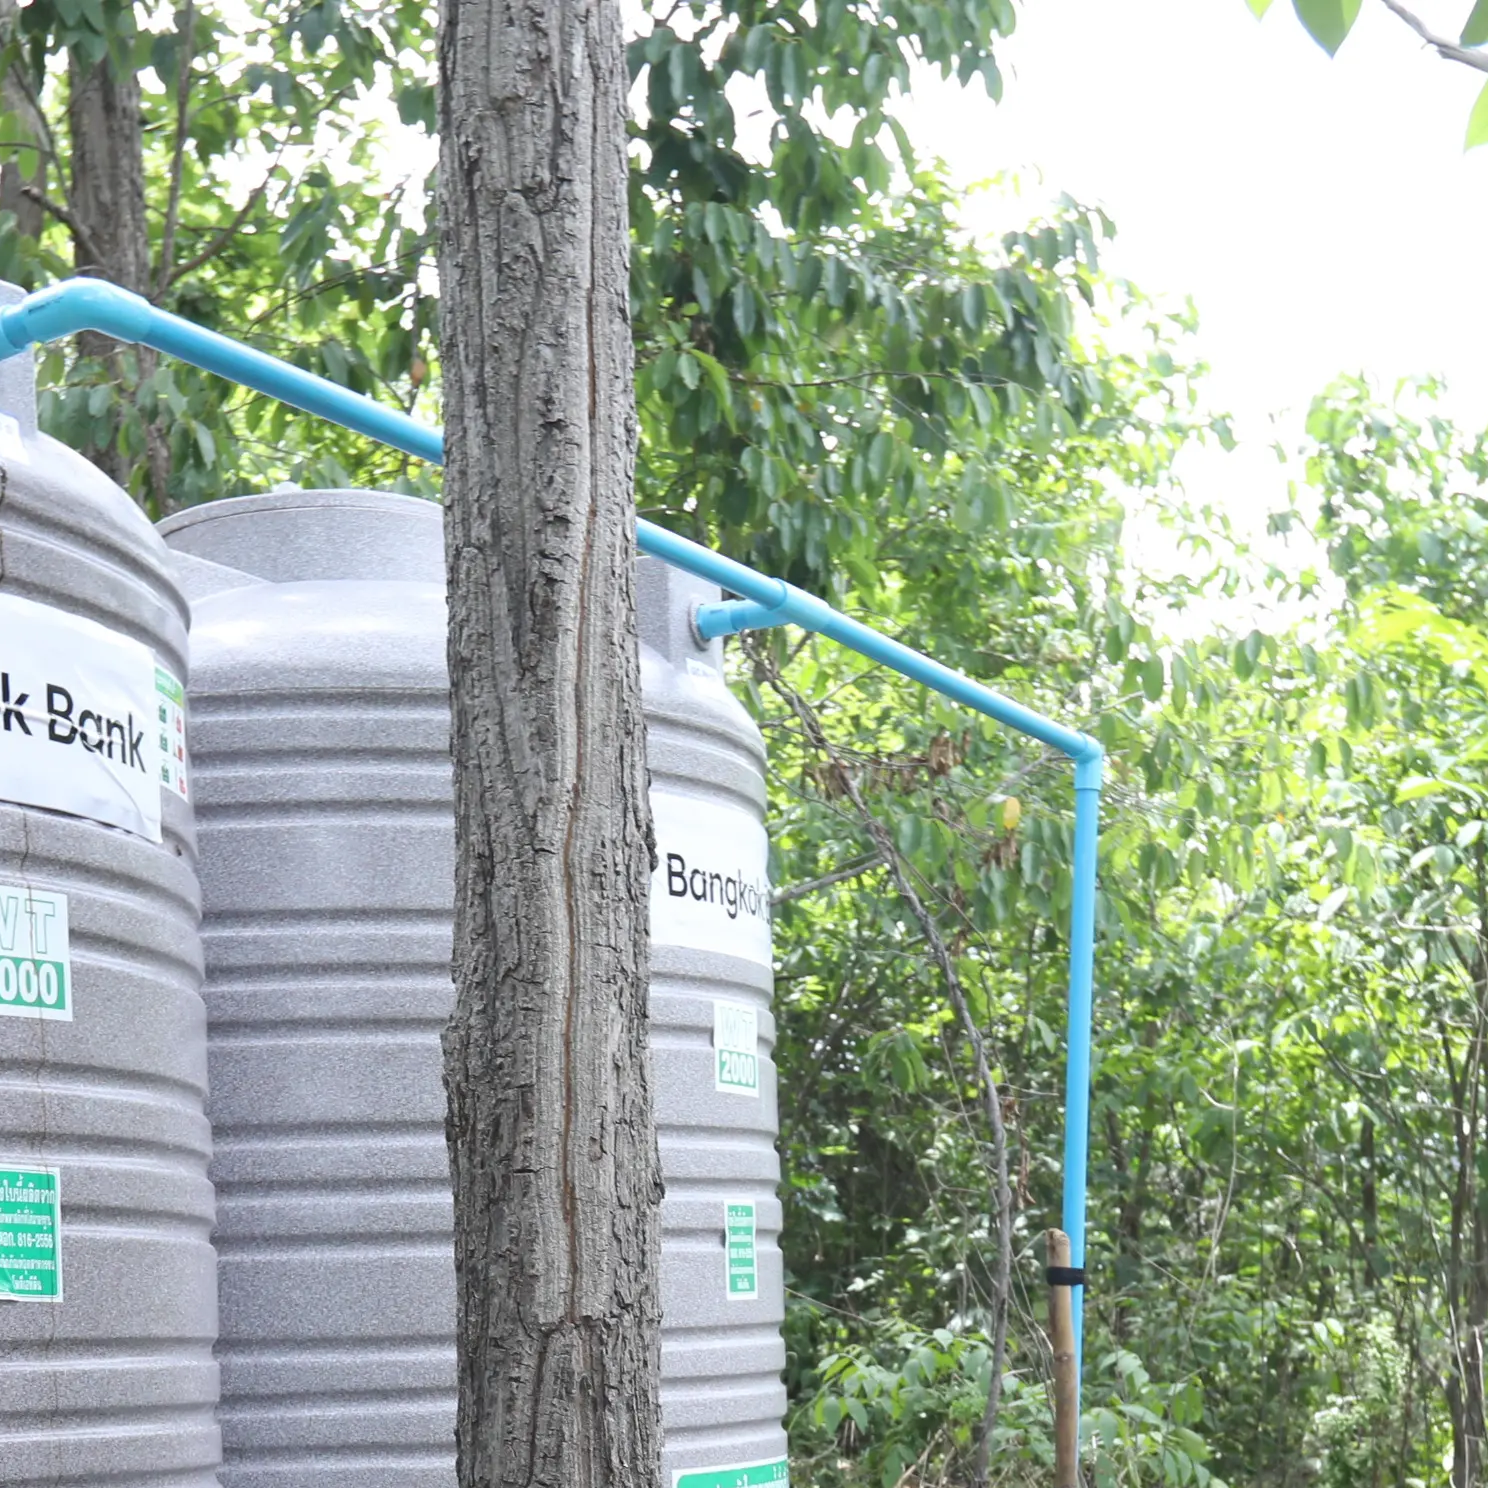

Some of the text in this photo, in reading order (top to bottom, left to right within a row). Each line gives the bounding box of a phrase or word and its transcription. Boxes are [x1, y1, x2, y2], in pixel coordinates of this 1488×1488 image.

[46, 683, 146, 773] Bank
[667, 853, 766, 920] Bangkok
[722, 1051, 754, 1085] 2000
